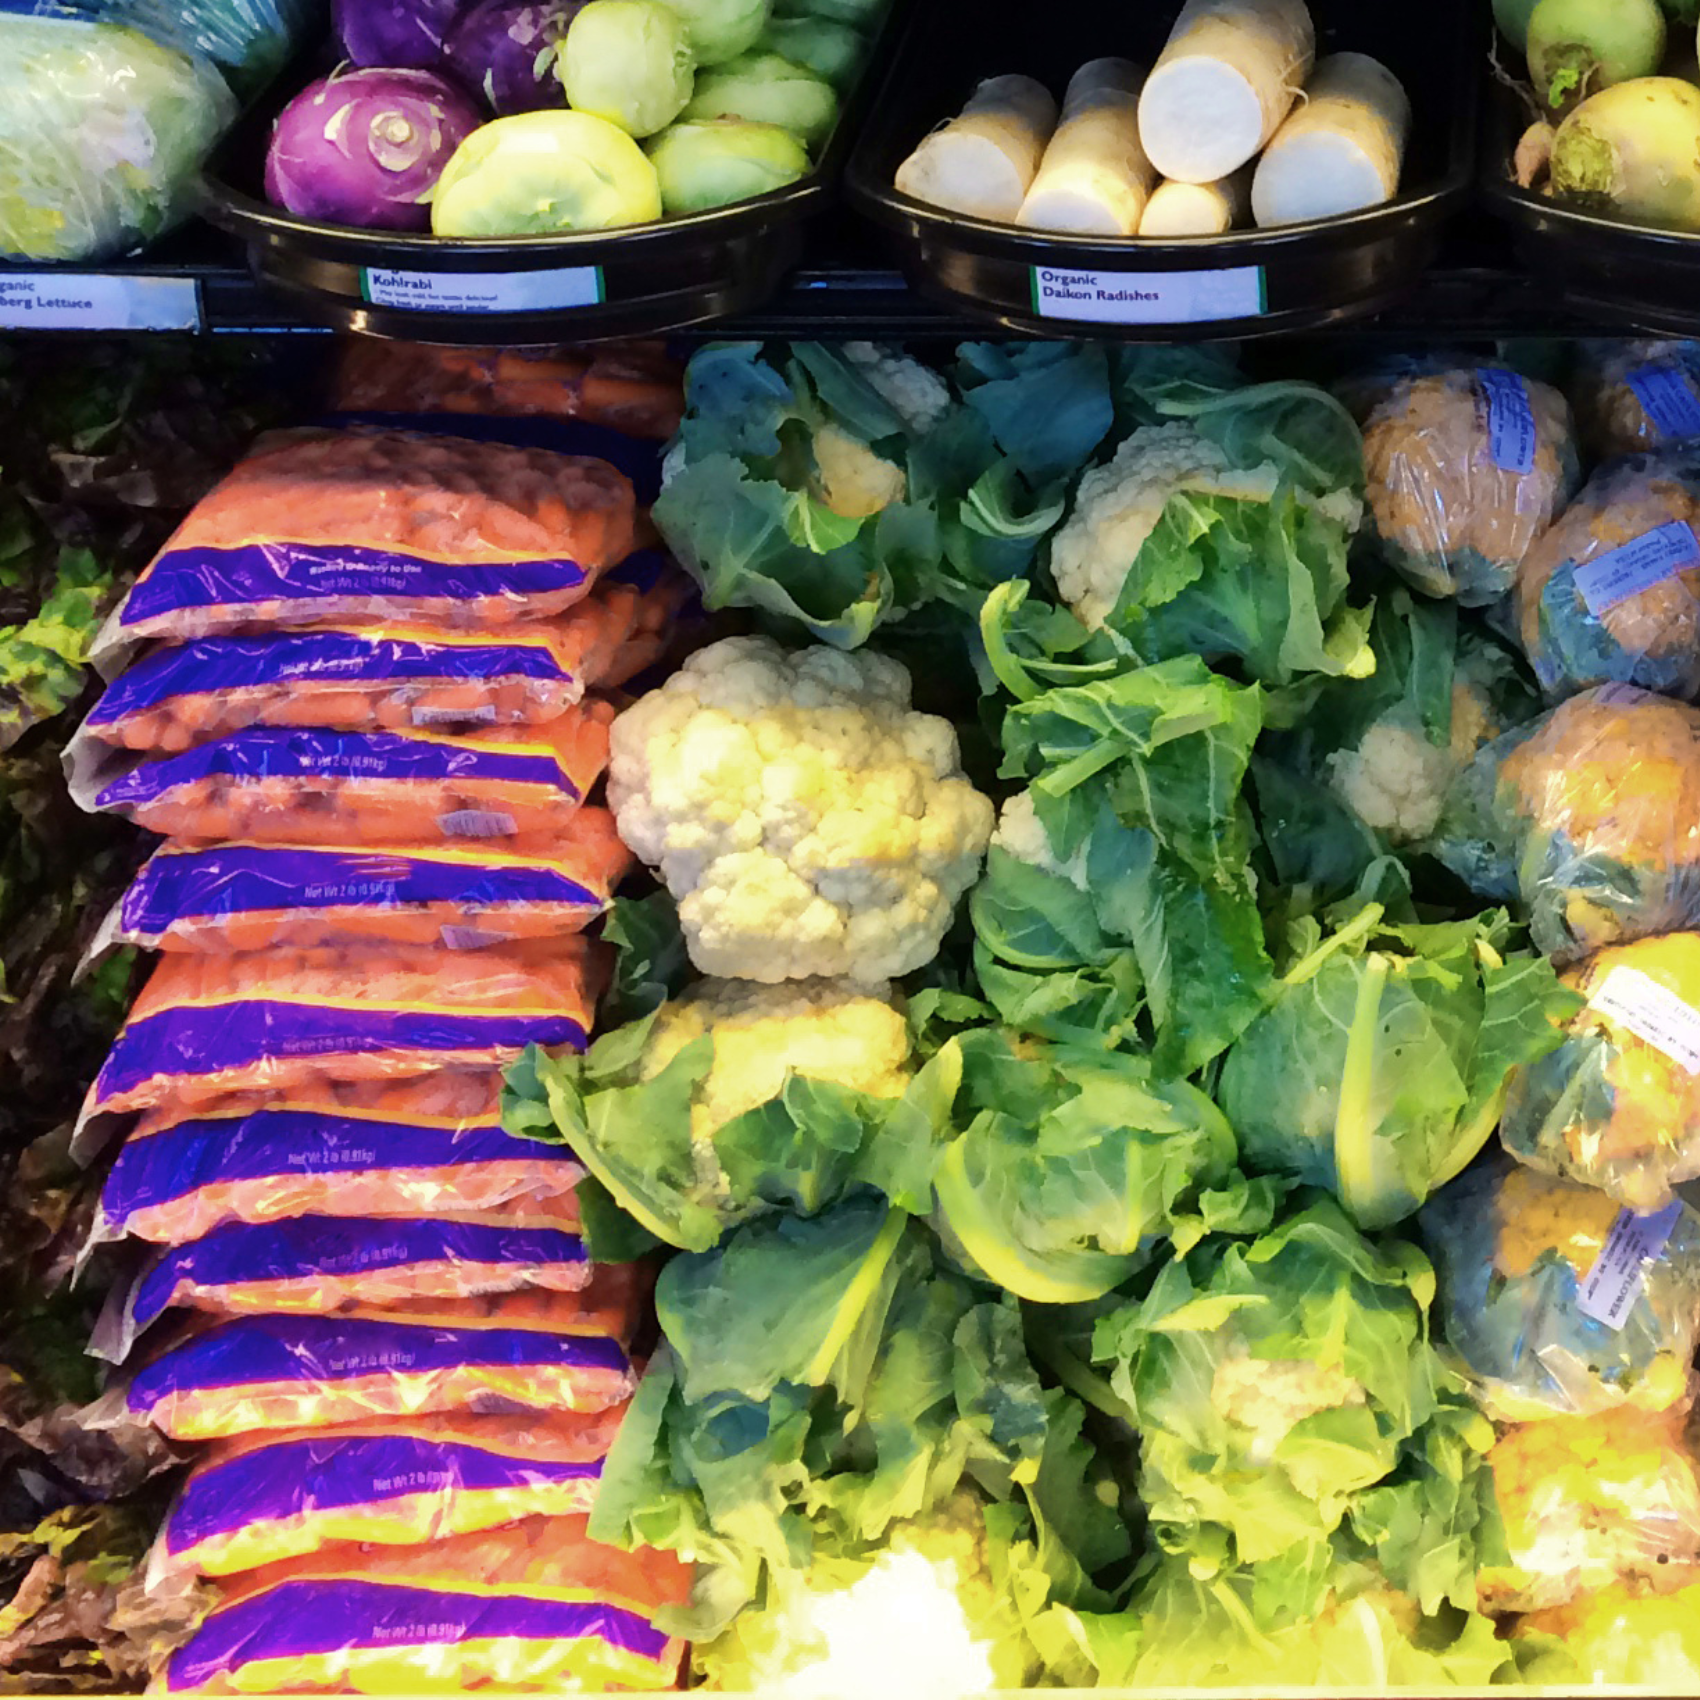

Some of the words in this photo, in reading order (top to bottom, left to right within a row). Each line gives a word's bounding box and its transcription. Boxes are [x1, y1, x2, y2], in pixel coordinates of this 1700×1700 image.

[373, 274, 433, 289] Kohlrabi
[1041, 270, 1097, 286] Organic
[0, 281, 35, 293] ganic
[1043, 286, 1092, 300] Daikon
[1096, 289, 1159, 301] Radishes
[0, 296, 33, 310] berg
[37, 296, 93, 309] Lettuce
